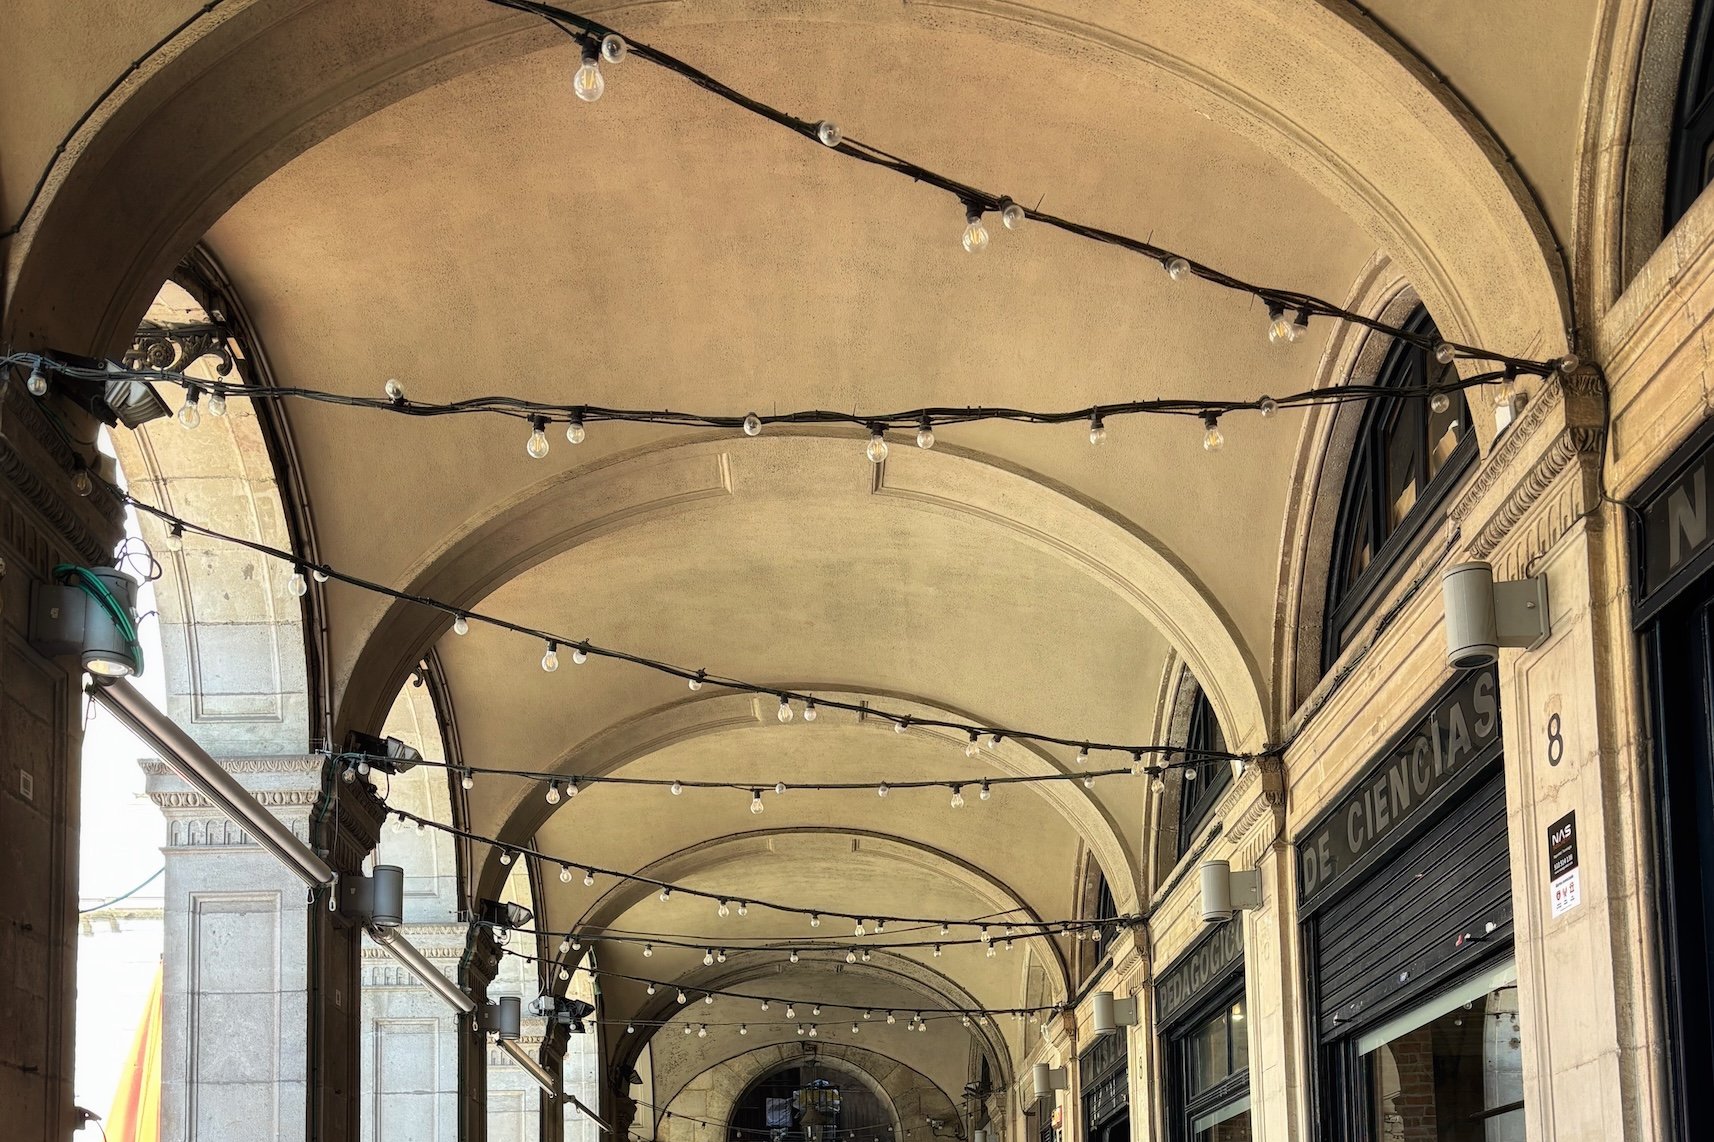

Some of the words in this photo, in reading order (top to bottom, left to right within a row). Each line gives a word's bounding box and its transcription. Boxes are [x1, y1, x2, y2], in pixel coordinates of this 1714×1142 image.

[1667, 465, 1707, 570] N
[1547, 712, 1564, 767] 8
[1302, 831, 1331, 891] DE
[1346, 671, 1497, 854] CIENCIAS
[1551, 823, 1572, 845] NAS
